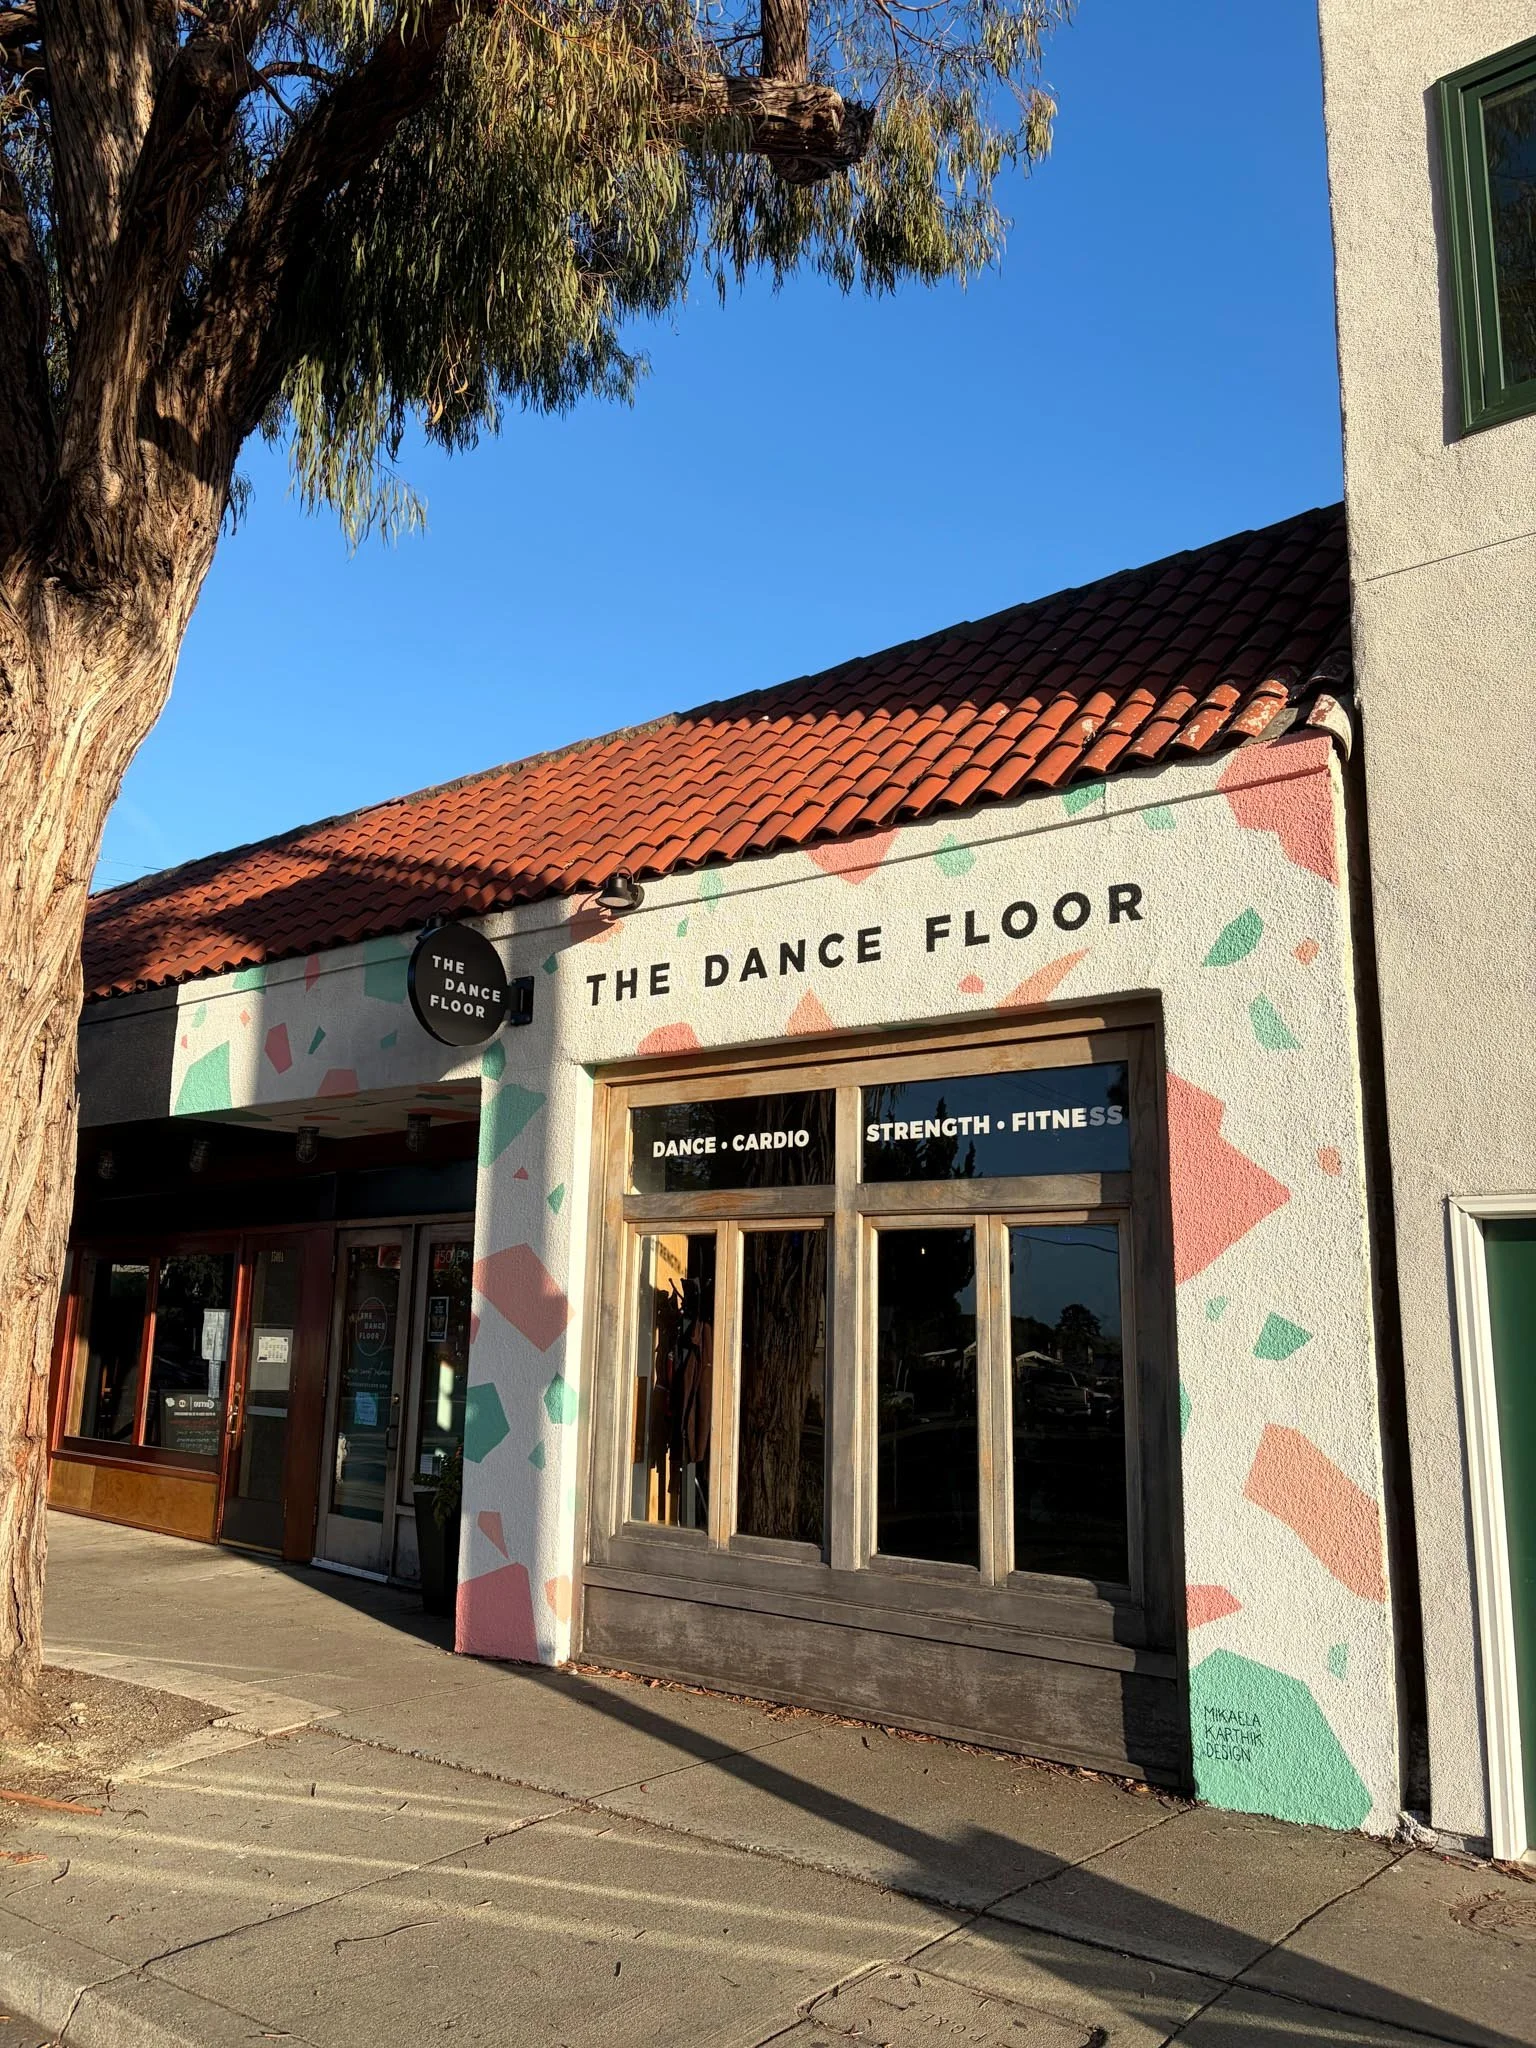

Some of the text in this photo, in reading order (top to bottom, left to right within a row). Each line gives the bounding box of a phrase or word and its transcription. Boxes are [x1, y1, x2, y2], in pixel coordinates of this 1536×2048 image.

[586, 882, 1144, 1006] THE DANCE FLOOR
[432, 955, 465, 975] THE
[445, 978, 501, 1003] DANCE
[430, 994, 485, 1019] FLOOR
[866, 1104, 1124, 1143] STRENGTH FITNESS
[652, 1129, 810, 1158] DANCE CARDIO
[360, 1332, 380, 1340] FLOOR
[1204, 1706, 1262, 1728] MIKAELA
[1205, 1725, 1265, 1748] KARTHIK
[1206, 1743, 1251, 1762] DESIGN
